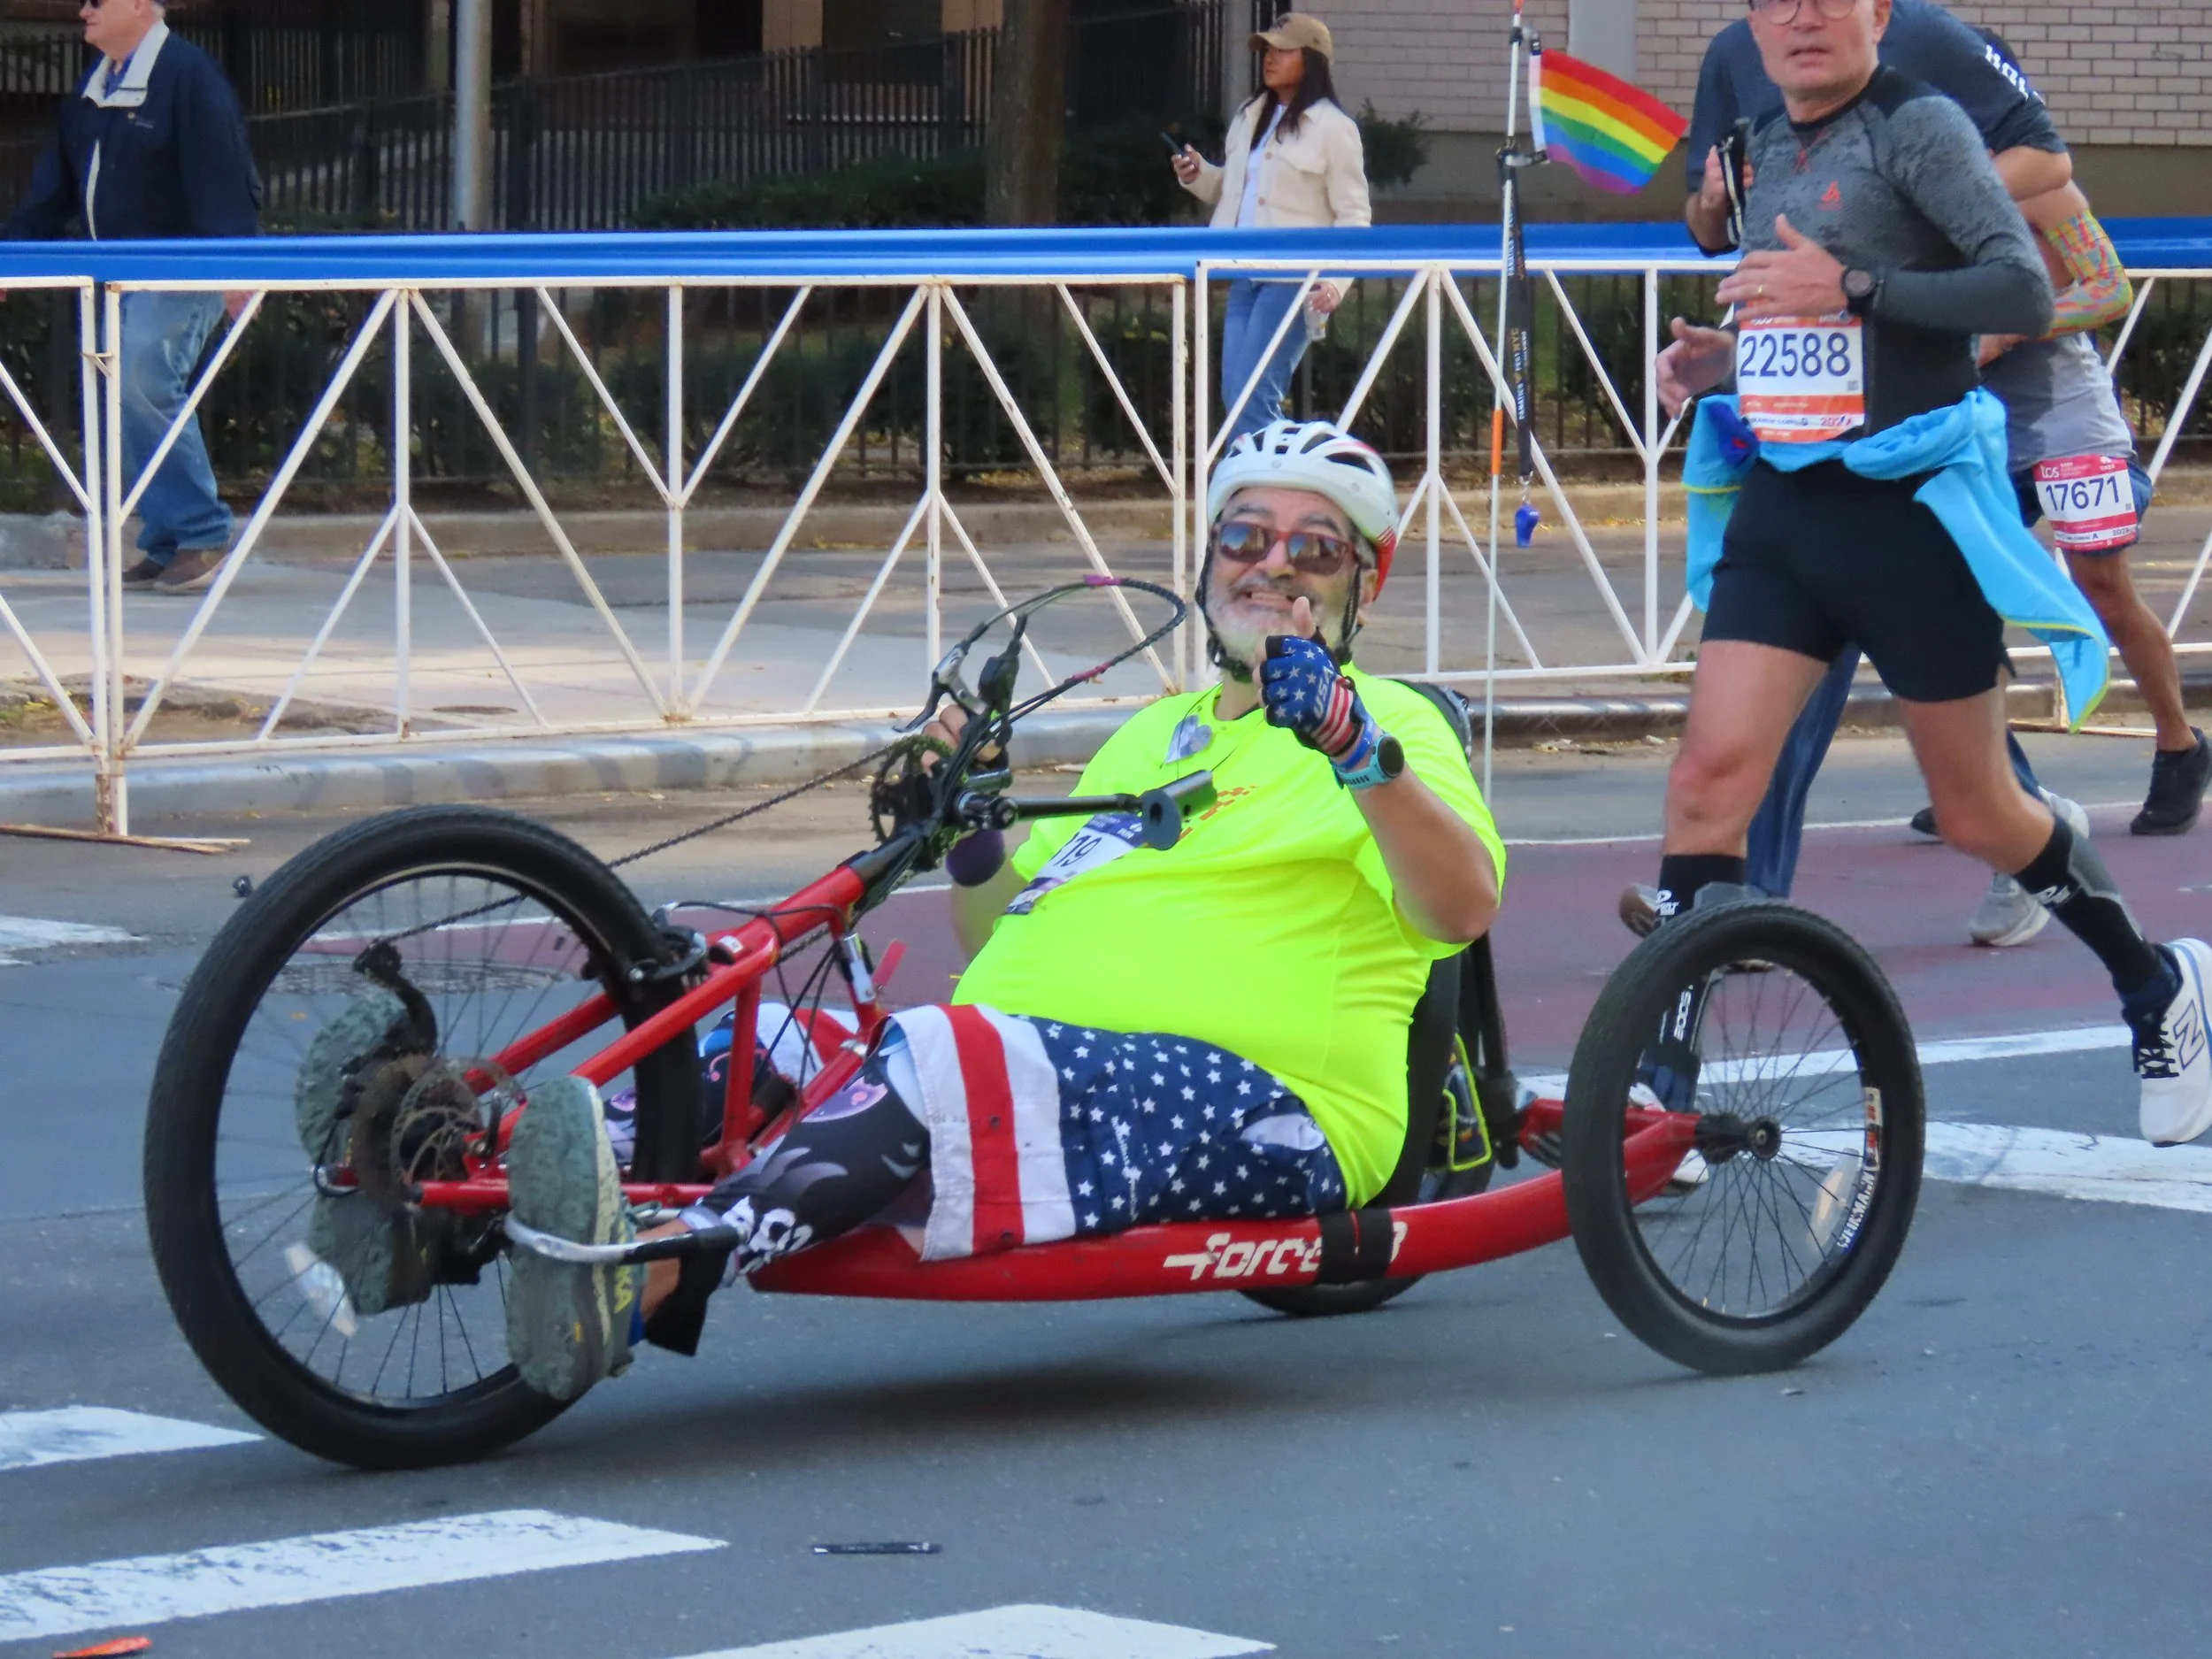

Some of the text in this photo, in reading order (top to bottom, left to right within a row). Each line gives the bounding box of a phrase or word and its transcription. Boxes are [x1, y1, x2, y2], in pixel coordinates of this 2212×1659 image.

[1510, 326, 1521, 351] NYC
[1739, 332, 1851, 377] 22588
[2040, 465, 2060, 479] tcs
[2046, 475, 2119, 511] 17671
[1313, 665, 1334, 718] USA
